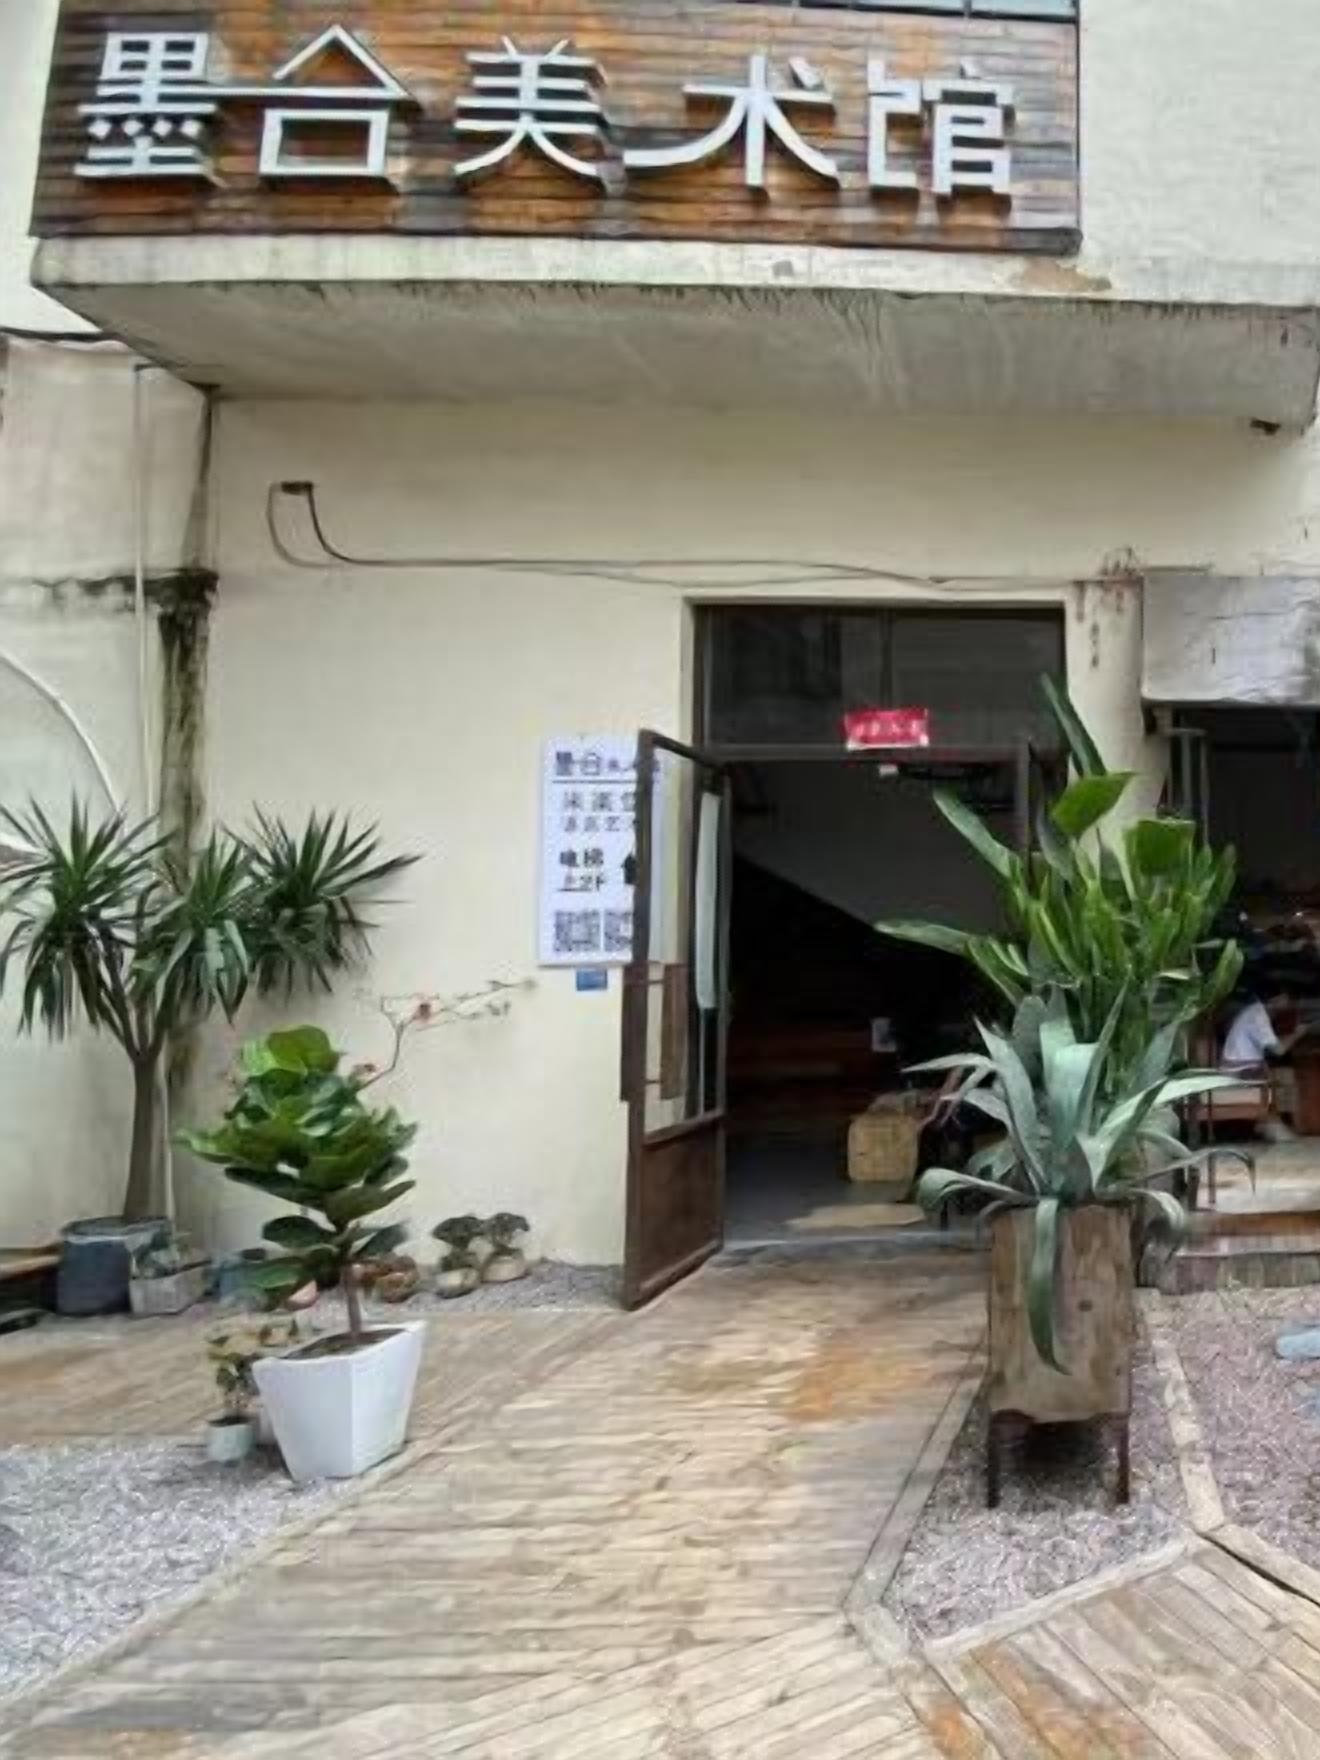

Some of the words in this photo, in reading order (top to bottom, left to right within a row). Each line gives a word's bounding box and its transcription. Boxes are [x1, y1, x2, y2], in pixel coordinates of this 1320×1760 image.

[76, 24, 1015, 196] 墨合美术馆
